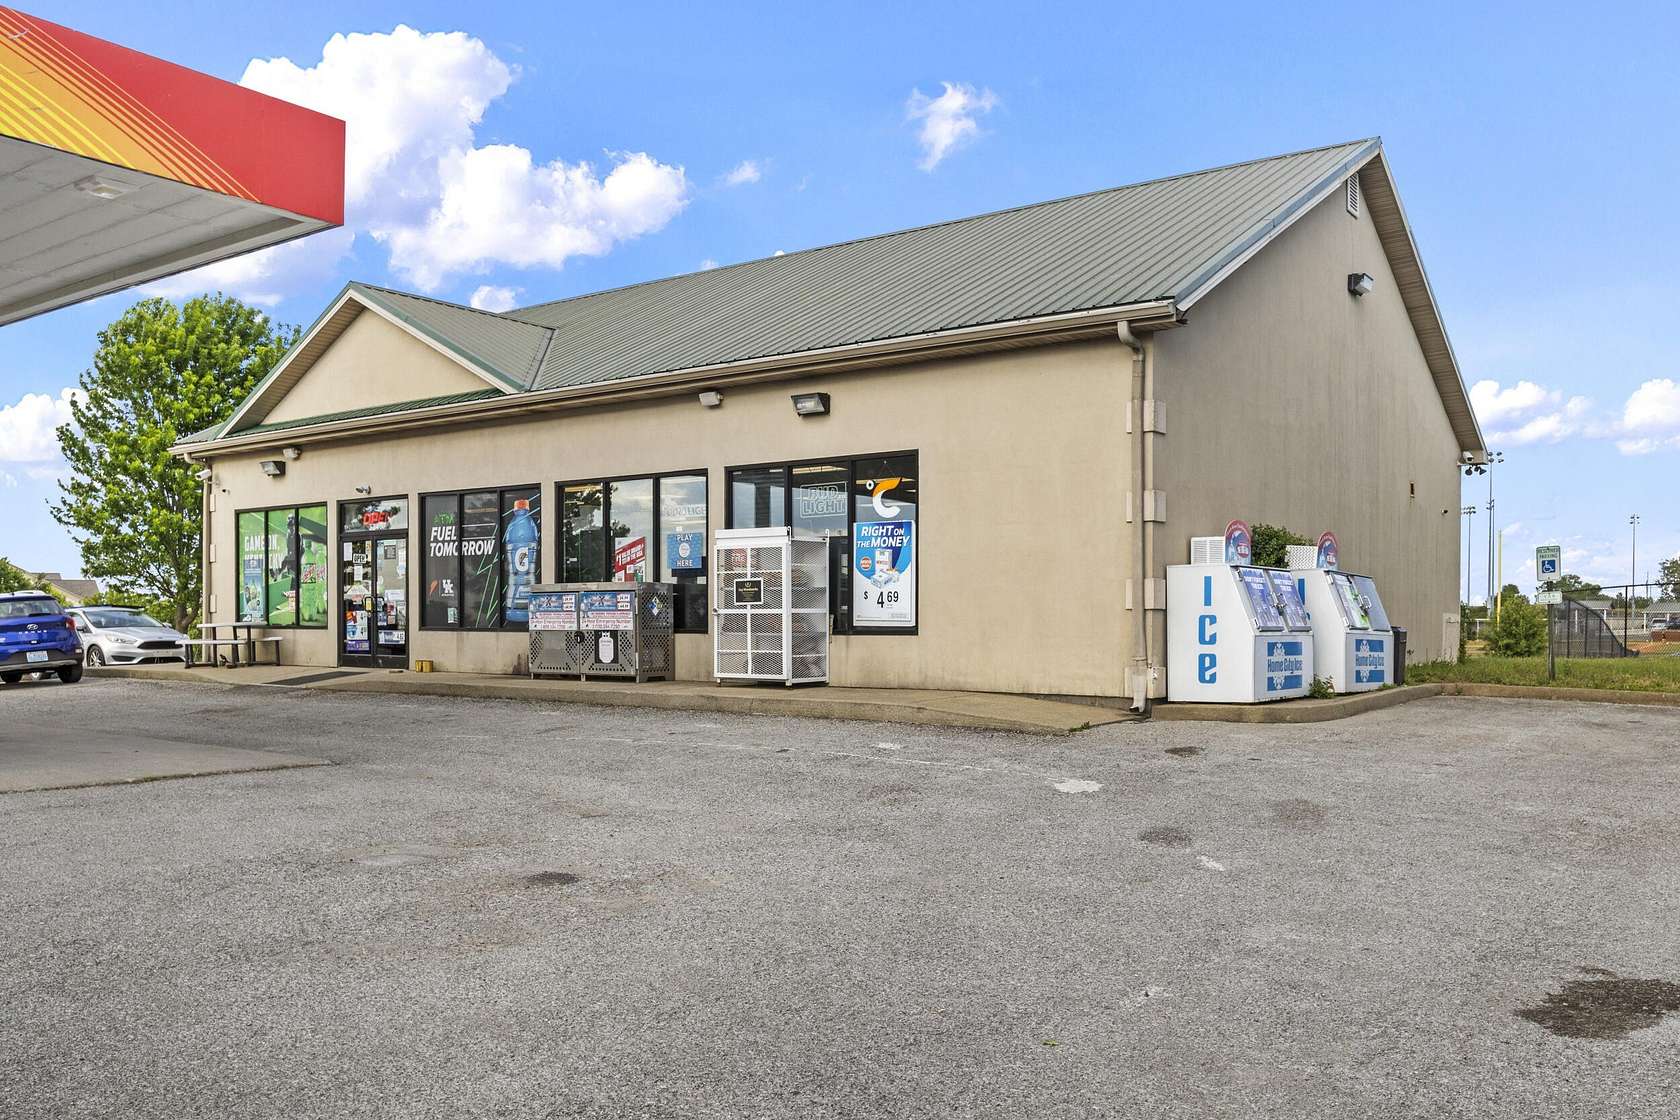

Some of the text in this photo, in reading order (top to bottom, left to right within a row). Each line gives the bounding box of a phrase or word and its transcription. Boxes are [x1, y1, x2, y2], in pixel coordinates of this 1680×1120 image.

[803, 500, 843, 514] LIGHT
[430, 526, 457, 541] FUEL
[861, 526, 905, 537] RIGHT ON
[676, 534, 693, 542] PLAY
[857, 536, 910, 548] THE MONEY
[430, 540, 495, 557] TOMORROW
[353, 554, 366, 563] OPEN
[863, 591, 869, 599] $
[1267, 659, 1284, 672] Home
[1355, 654, 1368, 667] Home
